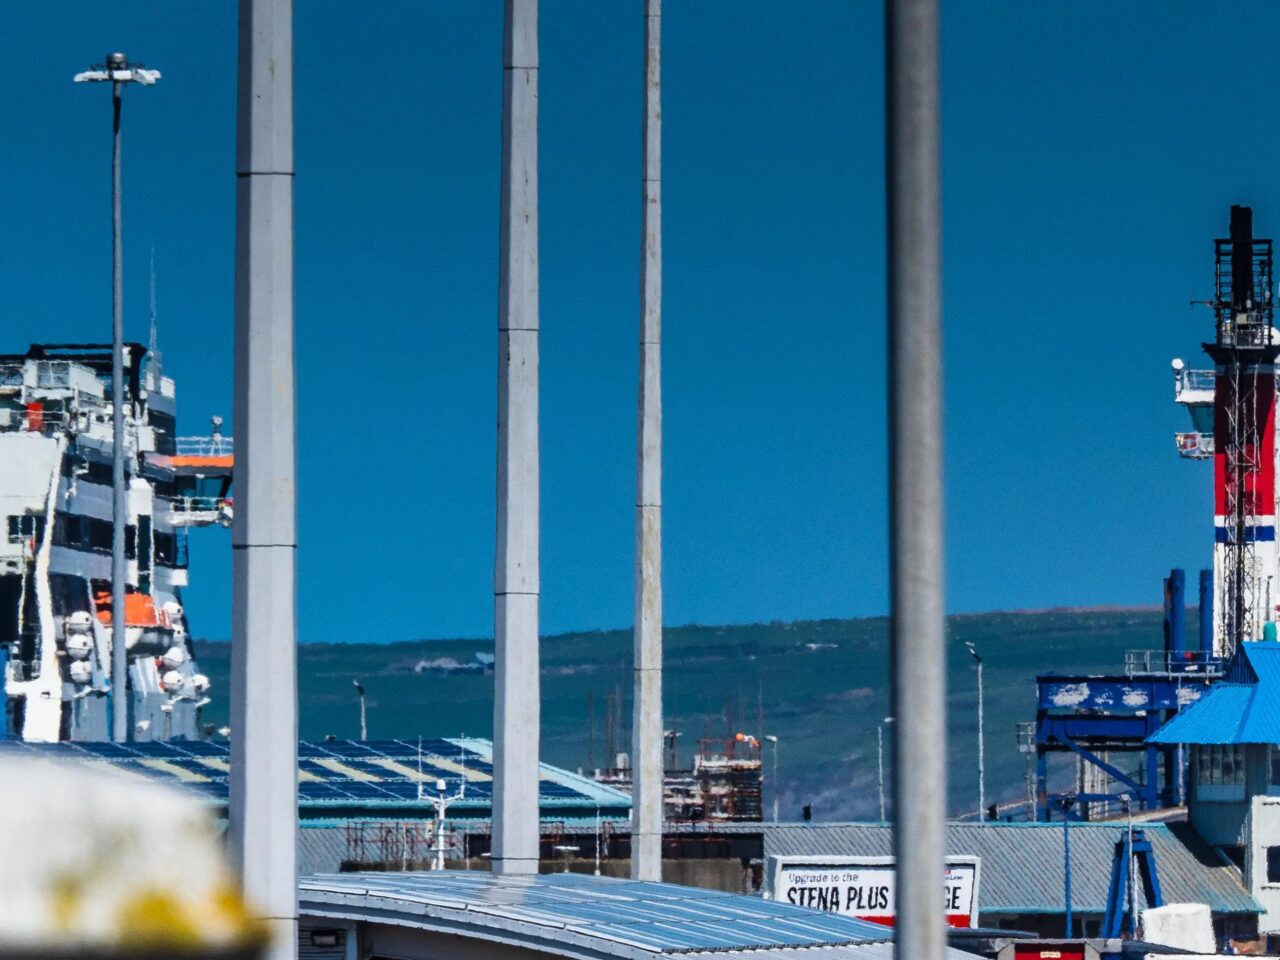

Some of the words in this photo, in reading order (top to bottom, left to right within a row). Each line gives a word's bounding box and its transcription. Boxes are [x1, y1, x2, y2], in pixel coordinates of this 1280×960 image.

[788, 872, 828, 884] Upgrade
[830, 873, 841, 882] to
[842, 872, 859, 882] the
[787, 886, 840, 912] STENA
[846, 886, 889, 910] PLUS
